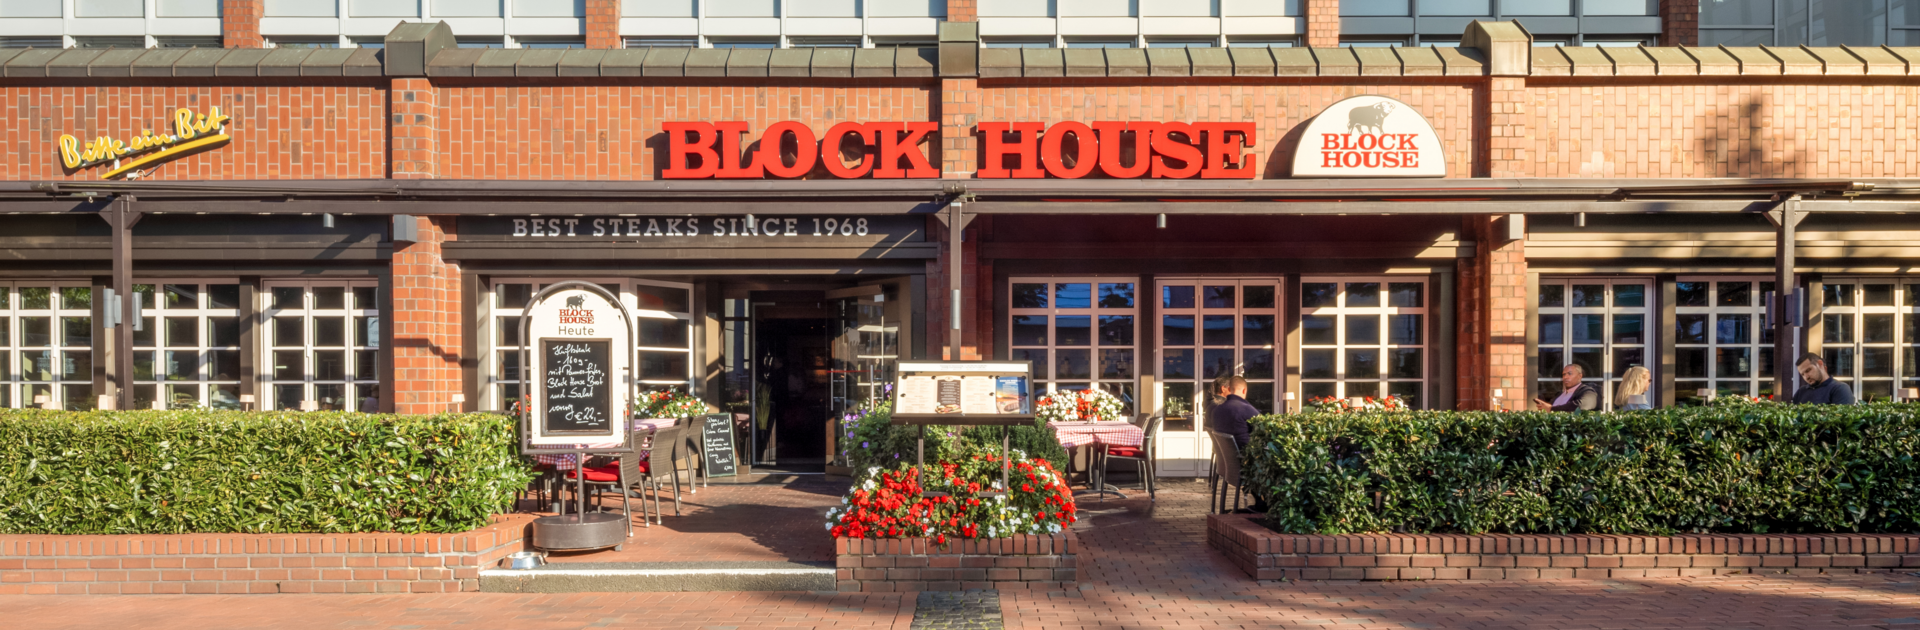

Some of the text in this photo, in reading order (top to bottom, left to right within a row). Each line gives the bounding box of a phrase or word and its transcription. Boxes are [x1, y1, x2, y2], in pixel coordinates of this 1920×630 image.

[59, 106, 230, 169] Bitte ein Bit
[1320, 133, 1419, 150] BLOCK
[662, 120, 1257, 179] BLOCK HOUSE
[1320, 151, 1419, 168] HOUSE
[512, 218, 869, 237] BEST STEAKS SINCE 1968
[559, 316, 595, 324] HOUSE
[558, 325, 595, 336] Heute
[547, 366, 561, 376] mit
[547, 377, 568, 389] Block
[567, 387, 594, 398] Salat
